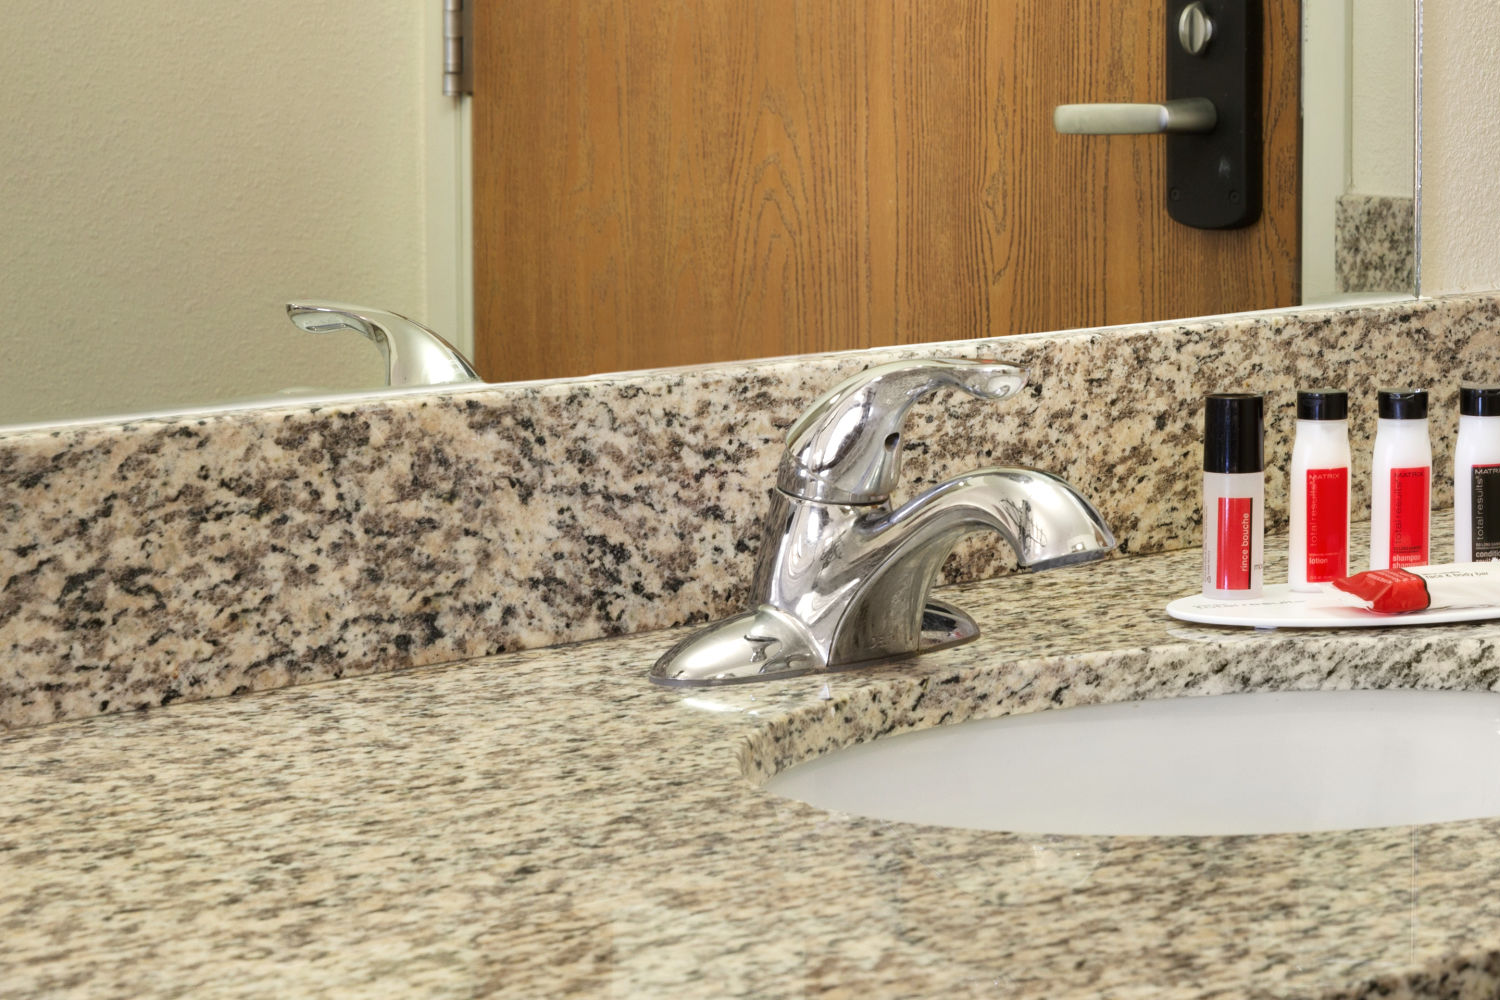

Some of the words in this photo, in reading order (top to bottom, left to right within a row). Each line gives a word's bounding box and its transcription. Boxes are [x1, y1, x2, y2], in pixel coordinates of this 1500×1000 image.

[1475, 477, 1484, 515] results
[1241, 513, 1250, 546] bouche
[1476, 516, 1484, 540] total
[1240, 549, 1249, 572] rince
[1309, 556, 1328, 565] lotion
